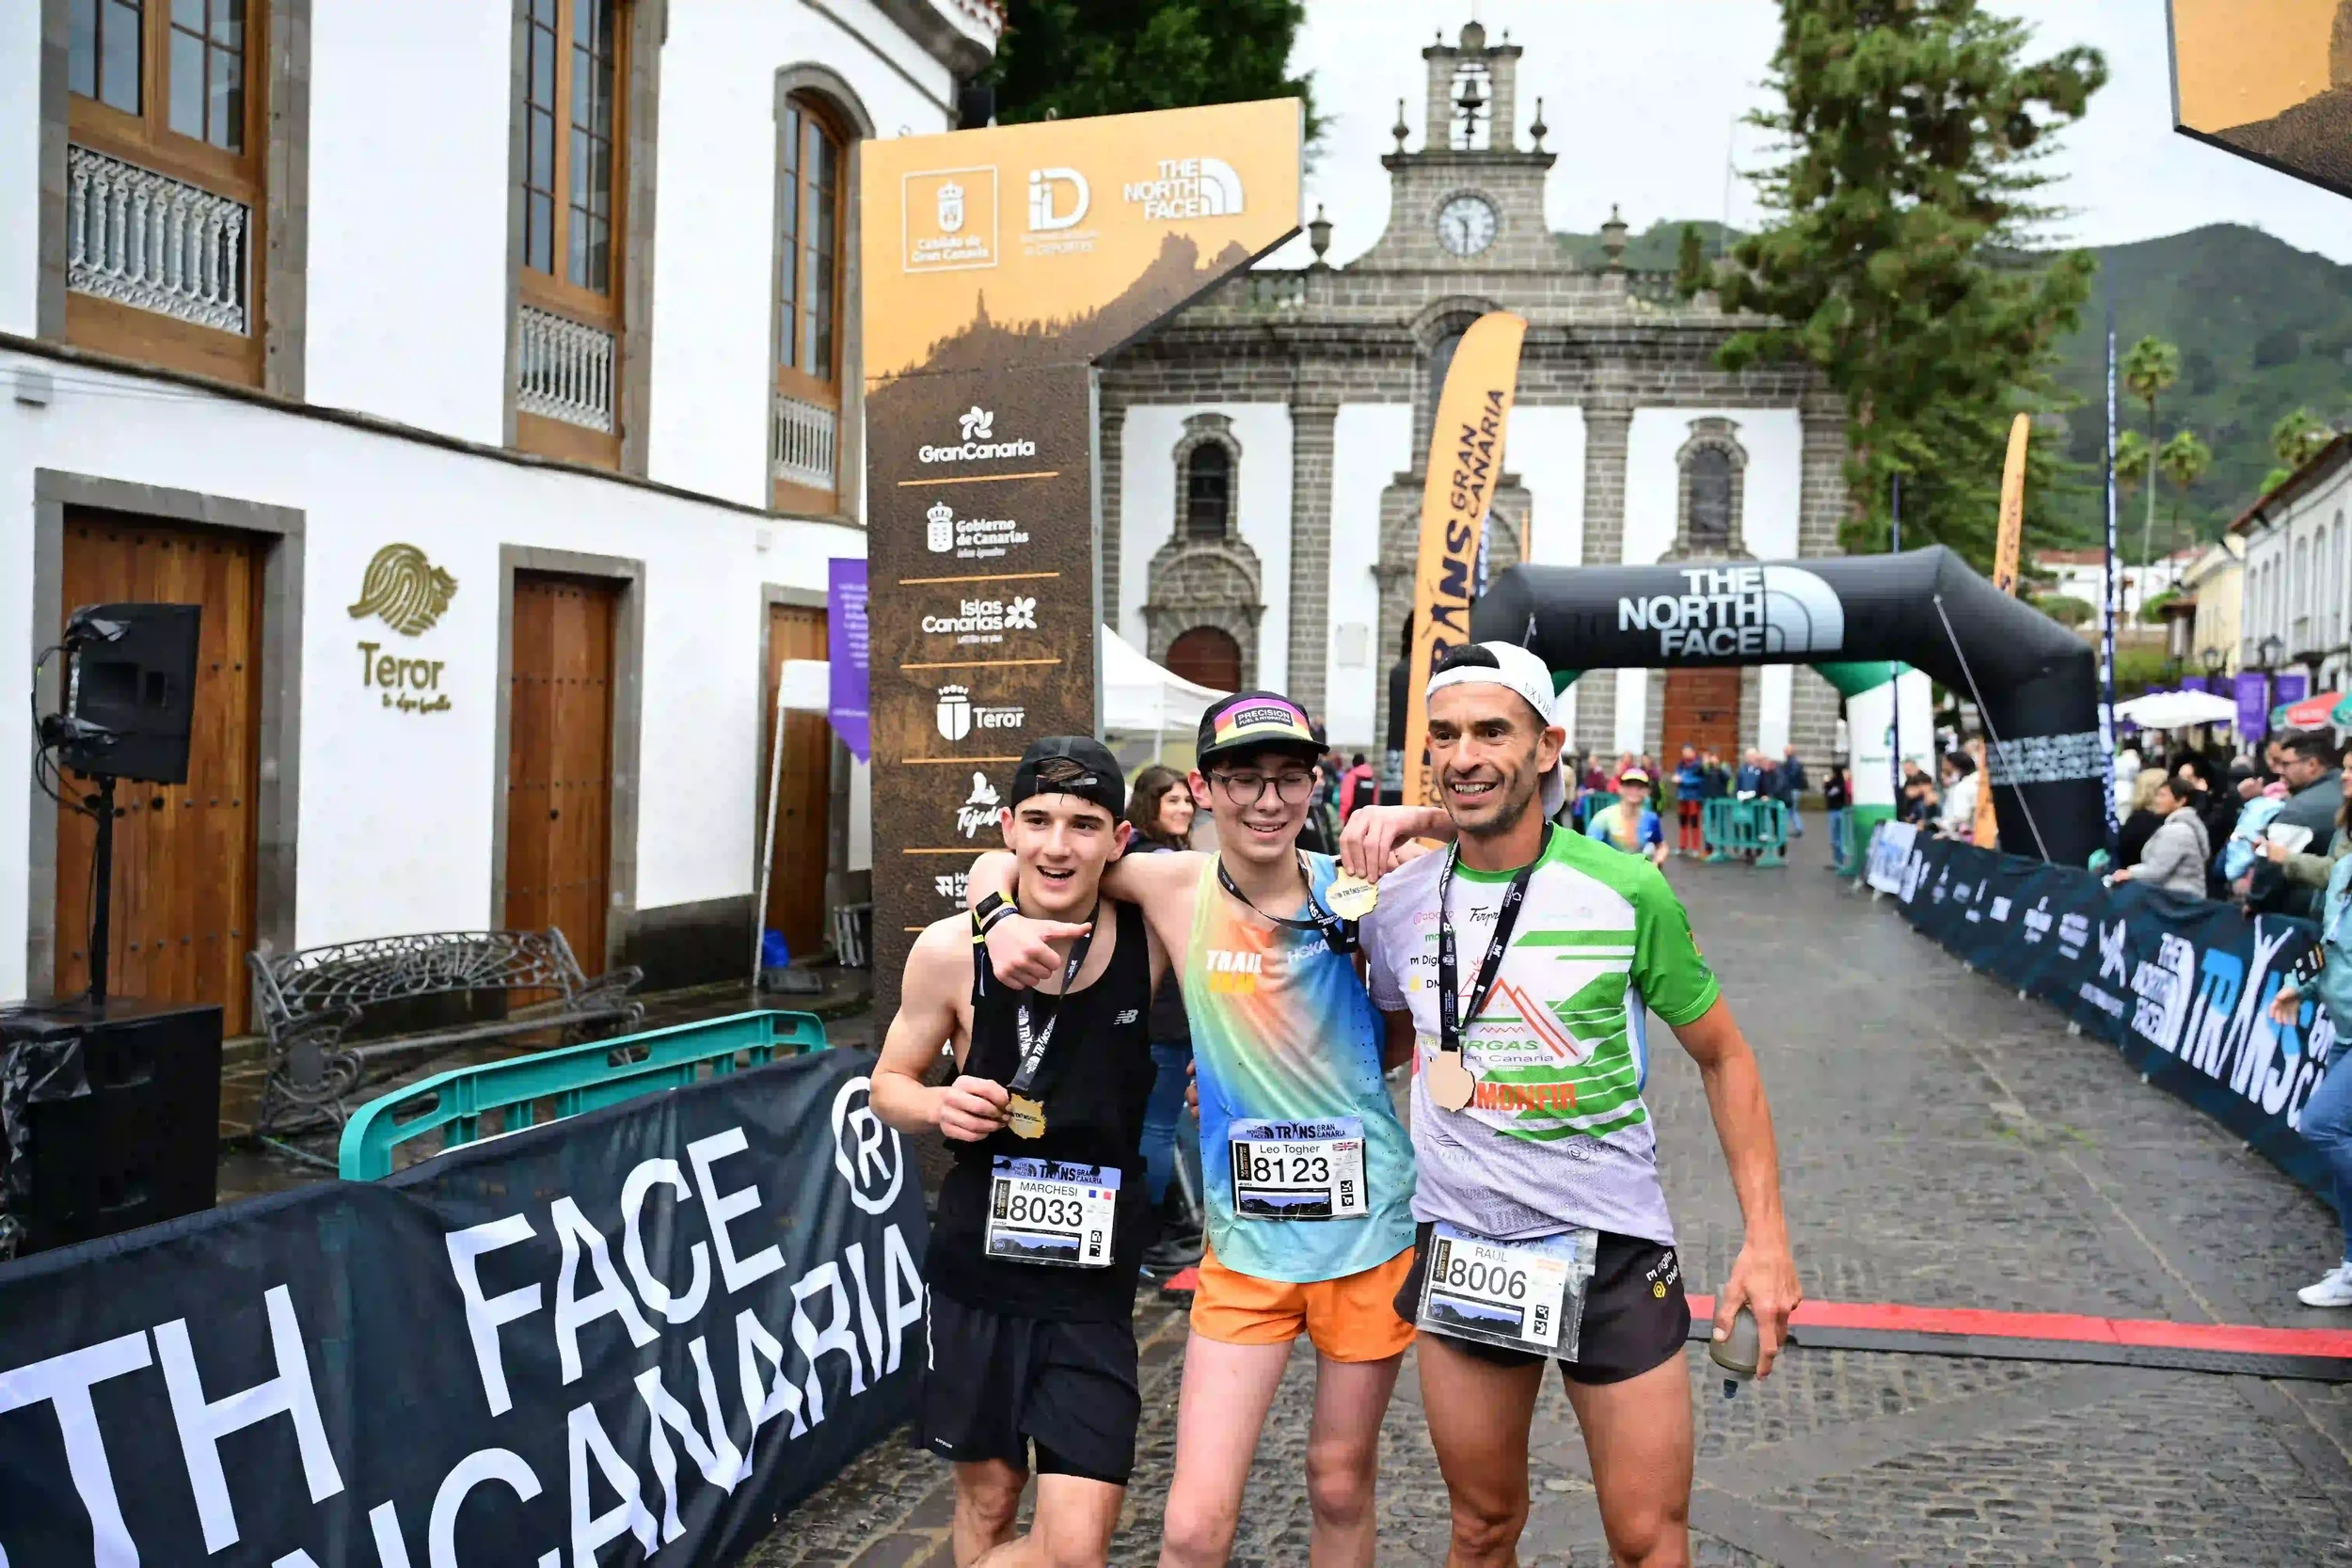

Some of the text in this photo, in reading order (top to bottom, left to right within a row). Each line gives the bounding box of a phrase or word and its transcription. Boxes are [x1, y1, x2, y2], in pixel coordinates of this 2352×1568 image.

[1157, 159, 1200, 180] THE
[1123, 179, 1200, 203] NORTH
[1144, 198, 1200, 219] FACE
[918, 438, 1036, 463] GranCanaria
[1466, 389, 1505, 518] CANARIA
[1451, 424, 1477, 511] GRAN
[956, 519, 1016, 533] Gobierno
[956, 531, 1029, 546] de Canarias
[1679, 565, 1762, 594] THE
[961, 599, 1003, 617] Islas
[1618, 591, 1763, 631] NORTH
[921, 615, 1003, 633] Canarias
[1660, 626, 1763, 657] FACE
[358, 641, 445, 690] Teror
[973, 706, 1025, 728] Teror
[1238, 709, 1290, 721] PRECISION
[1206, 939, 1330, 974] TRAIL HOKA
[1488, 1053, 1553, 1063] Canaria
[1275, 1121, 1316, 1139] TRANS
[1316, 1129, 1346, 1138] CANARIA
[1260, 1144, 1321, 1155] Leo Togher
[1075, 1175, 1102, 1184] CANARIA
[1253, 1157, 1329, 1182] 8123
[1020, 1181, 1078, 1196] MARCHESI
[1009, 1196, 1083, 1227] 8033
[1475, 1247, 1507, 1262] RAUL
[446, 1126, 787, 1418] FACE
[1449, 1259, 1528, 1299] 8006
